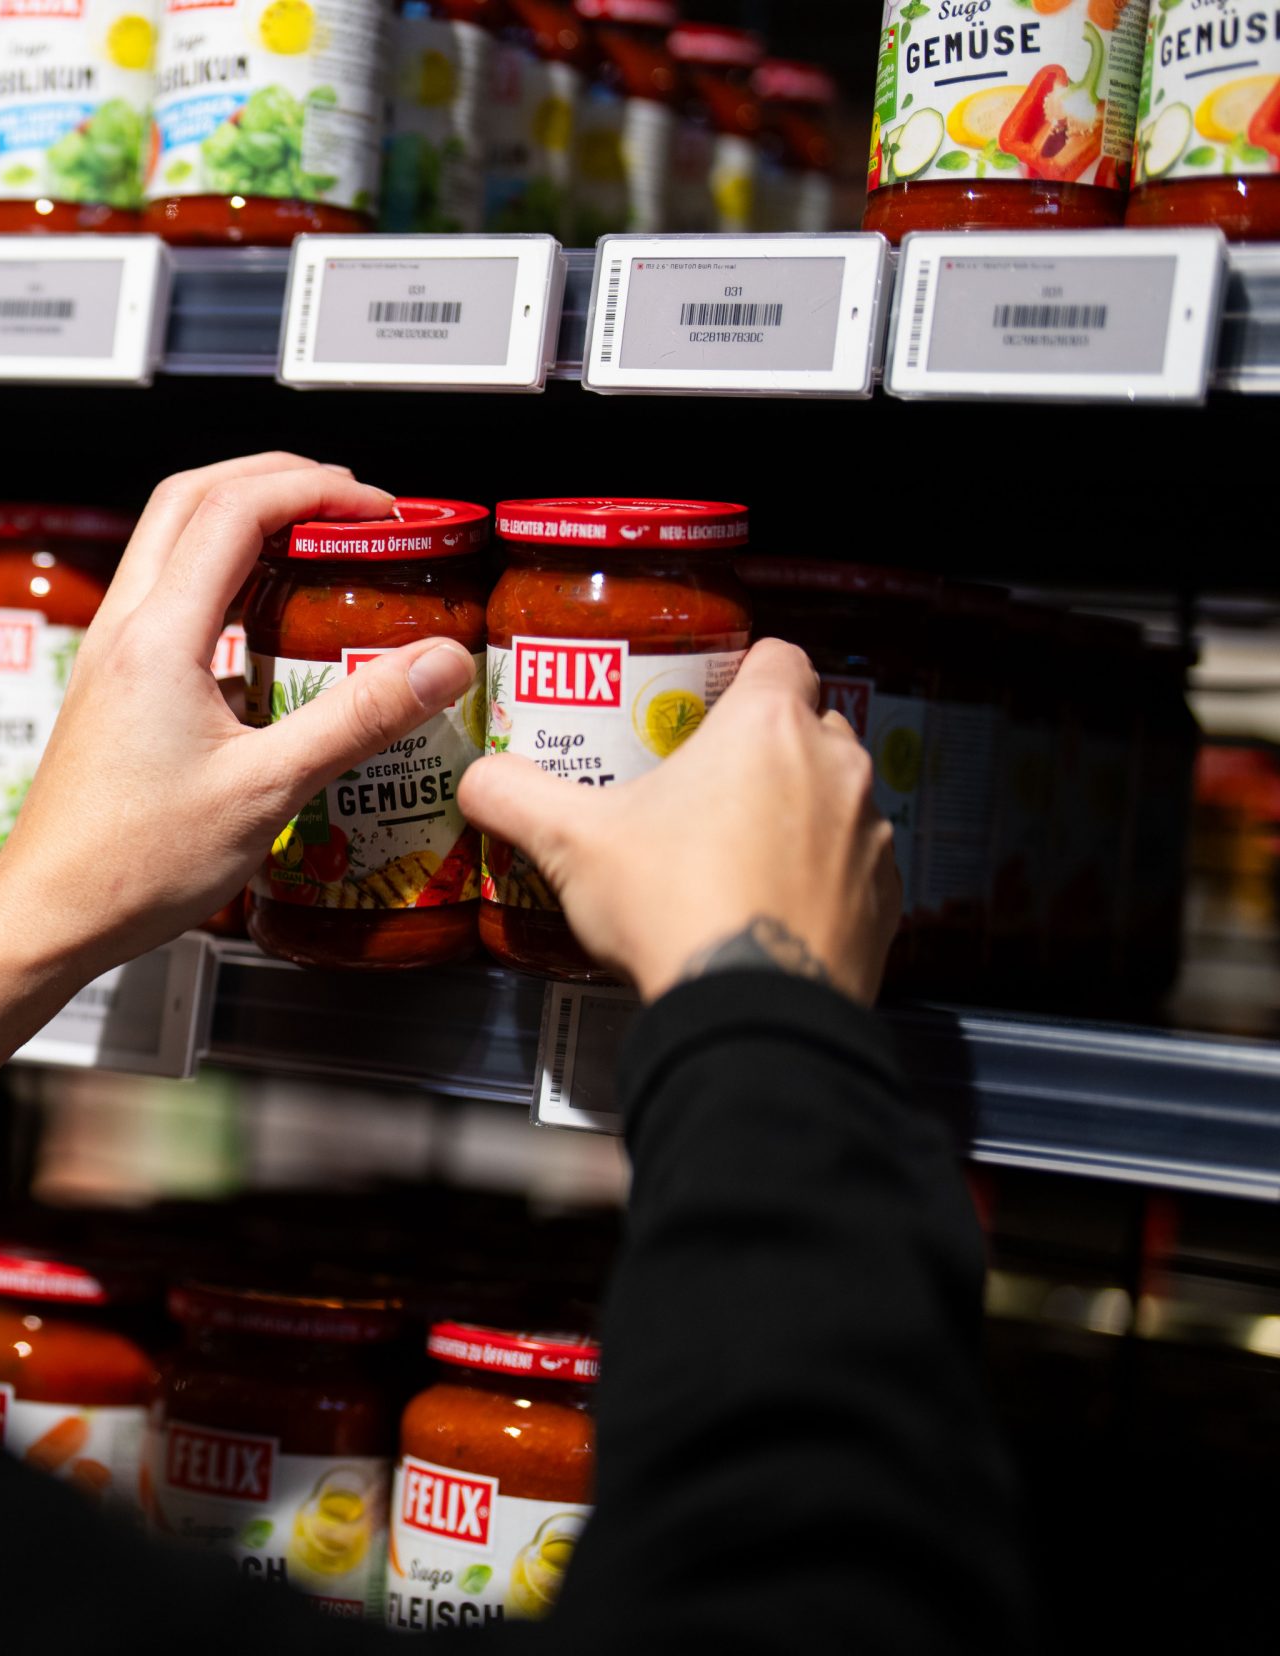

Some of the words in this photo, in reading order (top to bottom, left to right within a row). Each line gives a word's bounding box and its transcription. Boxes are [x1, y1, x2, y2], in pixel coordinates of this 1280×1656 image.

[938, 0, 991, 22] Sugo
[906, 21, 1041, 74] GEMÜSE
[1161, 9, 1280, 67] GEMÜS
[724, 286, 743, 296] 031
[509, 519, 544, 536] LEICHTER
[544, 521, 558, 537] ZU
[558, 519, 607, 539] ÖFFNEN!
[659, 525, 686, 541] NEU:
[295, 538, 318, 553] NEU:
[320, 539, 369, 554] LEICHTER
[370, 539, 385, 553] ZU
[387, 536, 432, 552] ÖFFNEN!
[520, 650, 614, 701] FELIX
[535, 730, 585, 755] Sugo
[366, 755, 443, 779] GEGRILLTES
[534, 756, 602, 772] GRILLTES
[337, 770, 455, 817] GEMÜSE
[173, 1431, 265, 1496] FELIX
[404, 1468, 484, 1537] FELIX
[410, 1558, 454, 1591] Sugo
